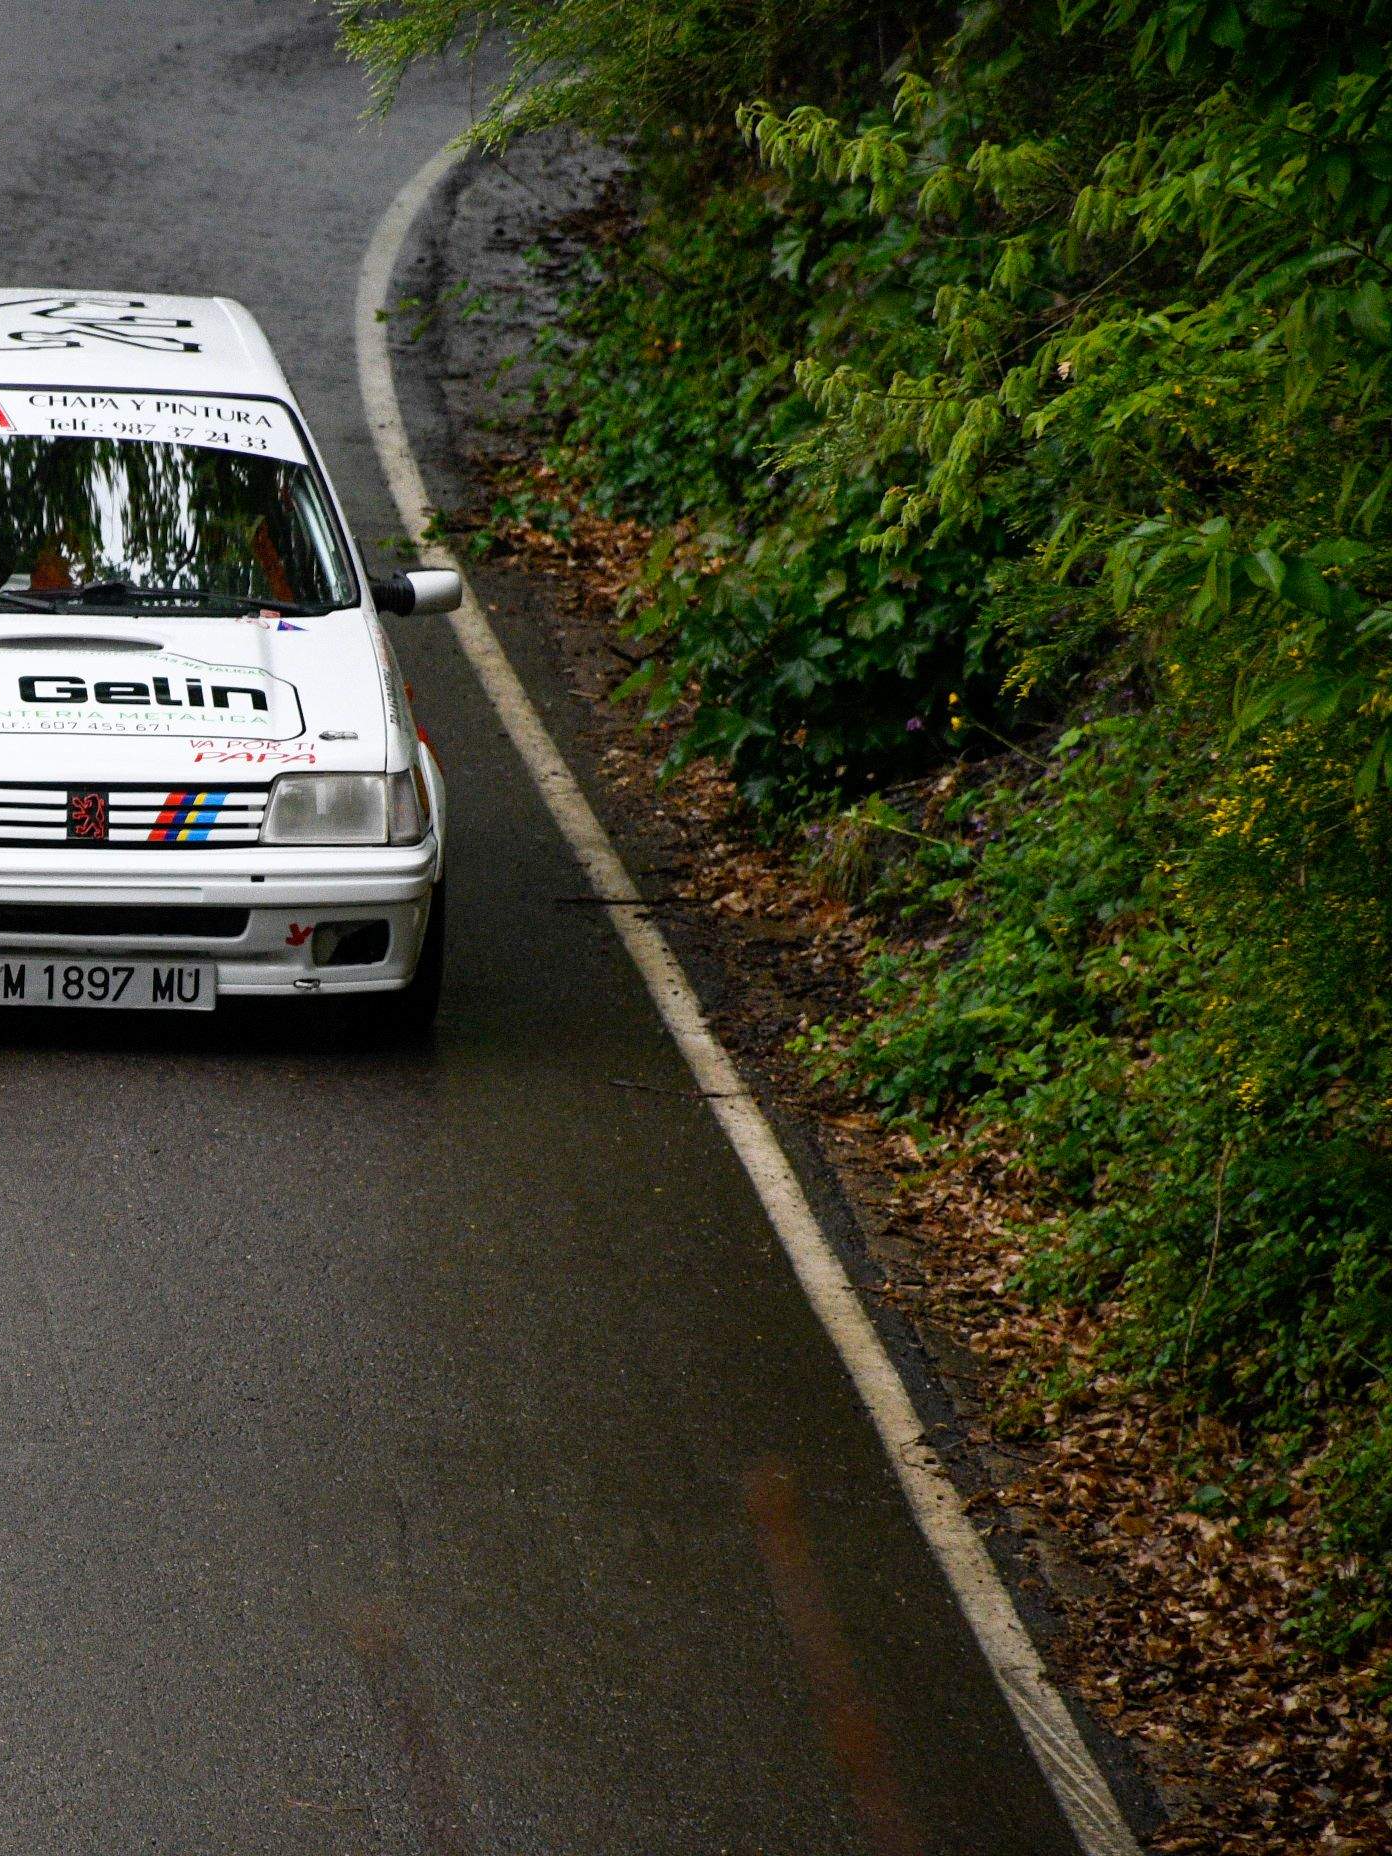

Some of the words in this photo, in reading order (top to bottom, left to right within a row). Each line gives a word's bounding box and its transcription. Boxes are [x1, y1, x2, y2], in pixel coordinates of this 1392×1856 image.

[28, 395, 119, 410] CHAPA
[131, 399, 146, 412] Y
[157, 401, 272, 428] PINTURA
[113, 421, 157, 436] 987
[168, 425, 194, 440] 37
[205, 431, 230, 445] 24
[240, 434, 268, 450] 33
[18, 676, 269, 712] Gelin
[41, 721, 78, 730] 607
[88, 722, 126, 732] 455
[136, 722, 171, 732] 671
[119, 711, 270, 725] METALICA
[189, 739, 215, 750] VA
[227, 739, 281, 751] POR
[296, 742, 315, 751] TI
[194, 751, 316, 764] PAPA
[3, 963, 26, 999] M
[43, 964, 135, 1002] 1897
[152, 967, 200, 1003] MU
